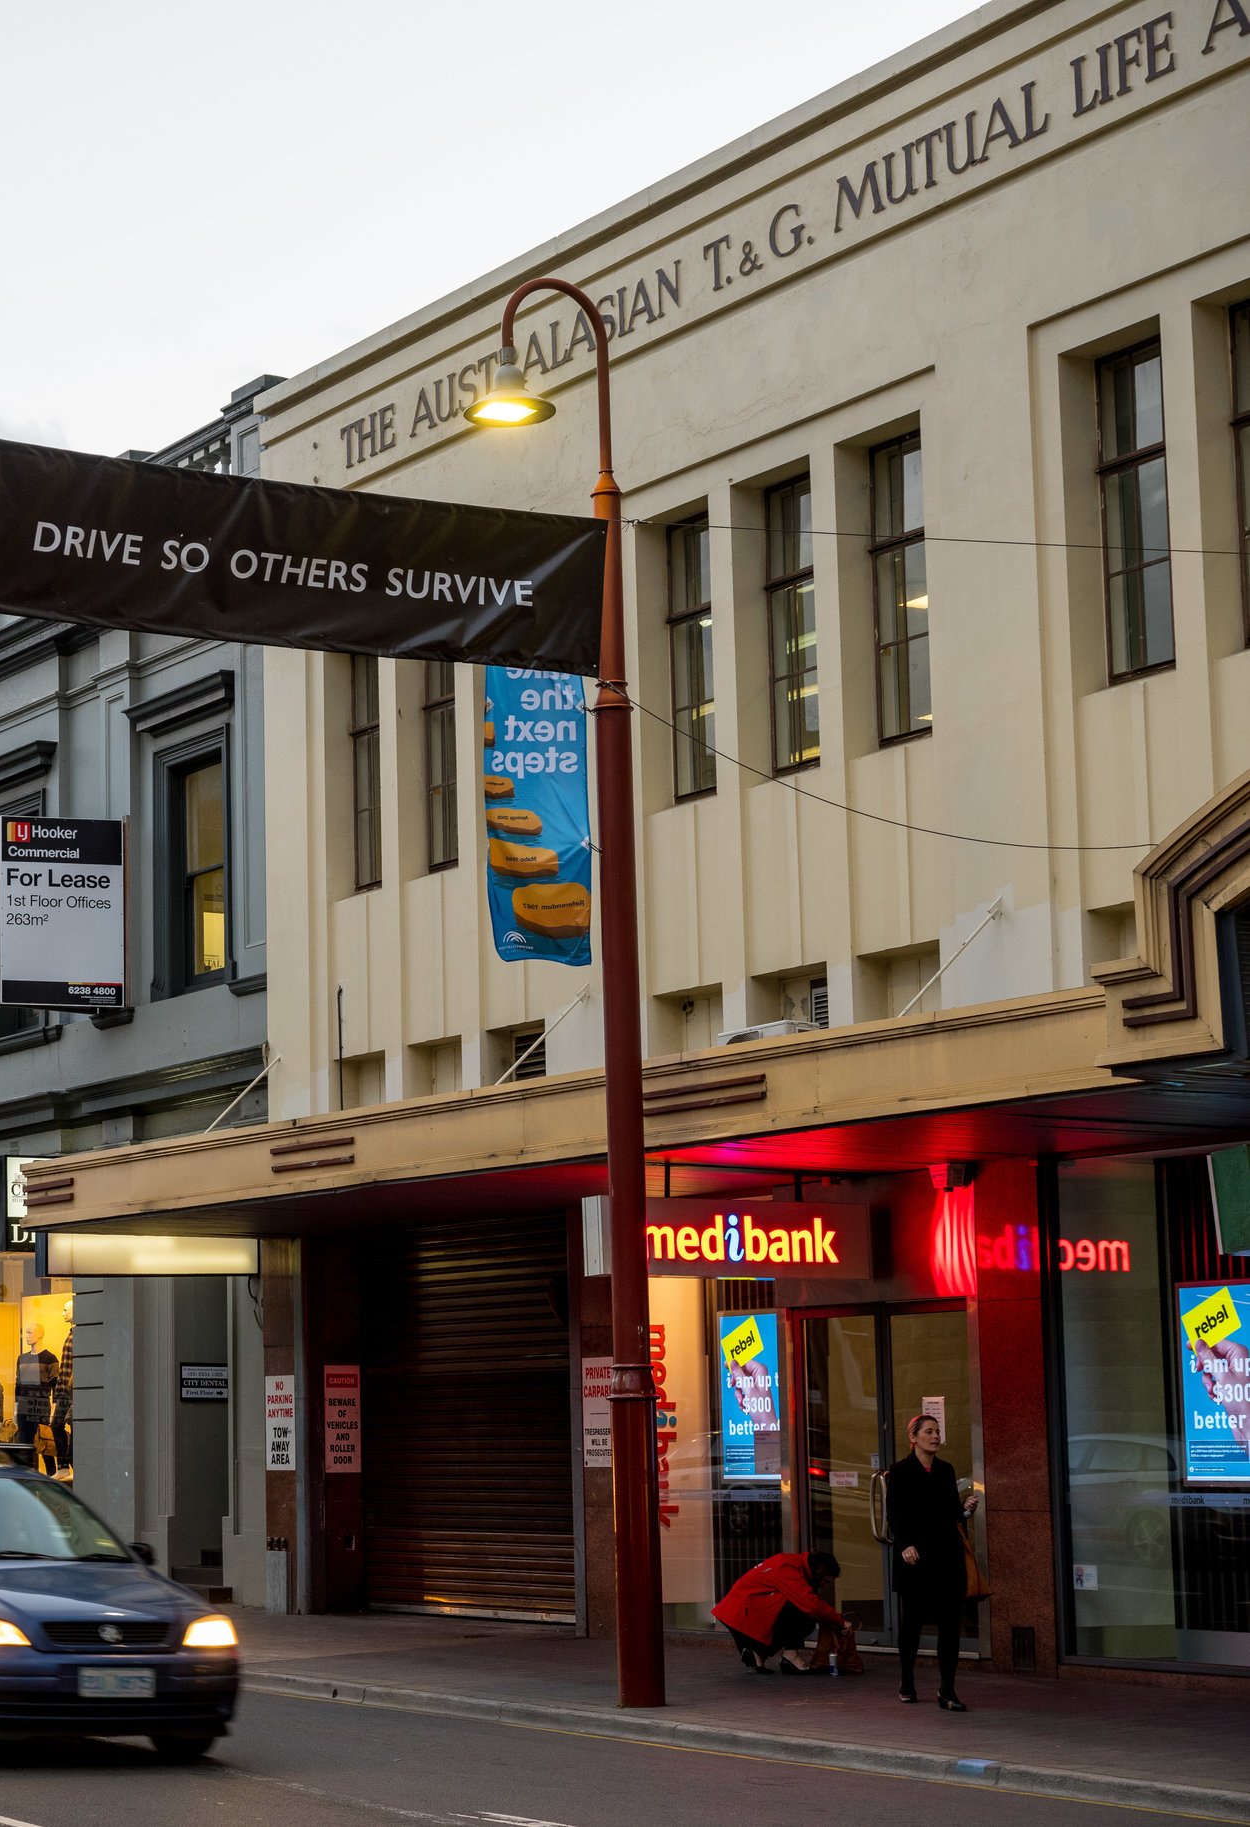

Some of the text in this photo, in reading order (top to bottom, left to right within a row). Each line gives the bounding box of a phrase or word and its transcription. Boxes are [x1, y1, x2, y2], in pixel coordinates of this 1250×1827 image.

[340, 402, 397, 469] THE
[409, 259, 682, 438] AUSTALASIAN
[769, 204, 815, 258] G.
[834, 80, 1050, 233] MUTUAL
[1070, 11, 1176, 118] LIFE
[33, 521, 533, 607] DRIVE SO OTHERS SURVIVE
[32, 825, 77, 839] Hooker
[8, 846, 80, 859] Commercial
[6, 868, 111, 889] For Lease
[7, 895, 111, 909] 1st Floor Offices
[68, 986, 116, 996] 6238 4800
[646, 1214, 839, 1263] medibank
[1195, 1304, 1229, 1338] rebel
[729, 1330, 755, 1359] rebel
[1203, 1358, 1229, 1373] am
[585, 1367, 611, 1380] PRIVATE
[275, 1381, 284, 1391] NO
[736, 1375, 754, 1388] am
[758, 1375, 772, 1391] up
[583, 1385, 611, 1398] CARPAR
[267, 1394, 293, 1405] PARKING
[328, 1398, 356, 1406] BEWARE
[742, 1396, 772, 1415] $300
[267, 1408, 293, 1418] ANYTIME
[338, 1410, 347, 1418] OF
[1195, 1410, 1247, 1429] better
[327, 1421, 358, 1430] VEHICLES
[584, 1428, 611, 1436] TRESPASSER
[729, 1420, 767, 1436] better
[336, 1433, 350, 1441] AND
[591, 1438, 601, 1446] WILL
[271, 1441, 290, 1452] AWAY
[330, 1444, 355, 1453] ROLLER
[271, 1453, 290, 1465] AREA
[333, 1456, 352, 1464] DOOR
